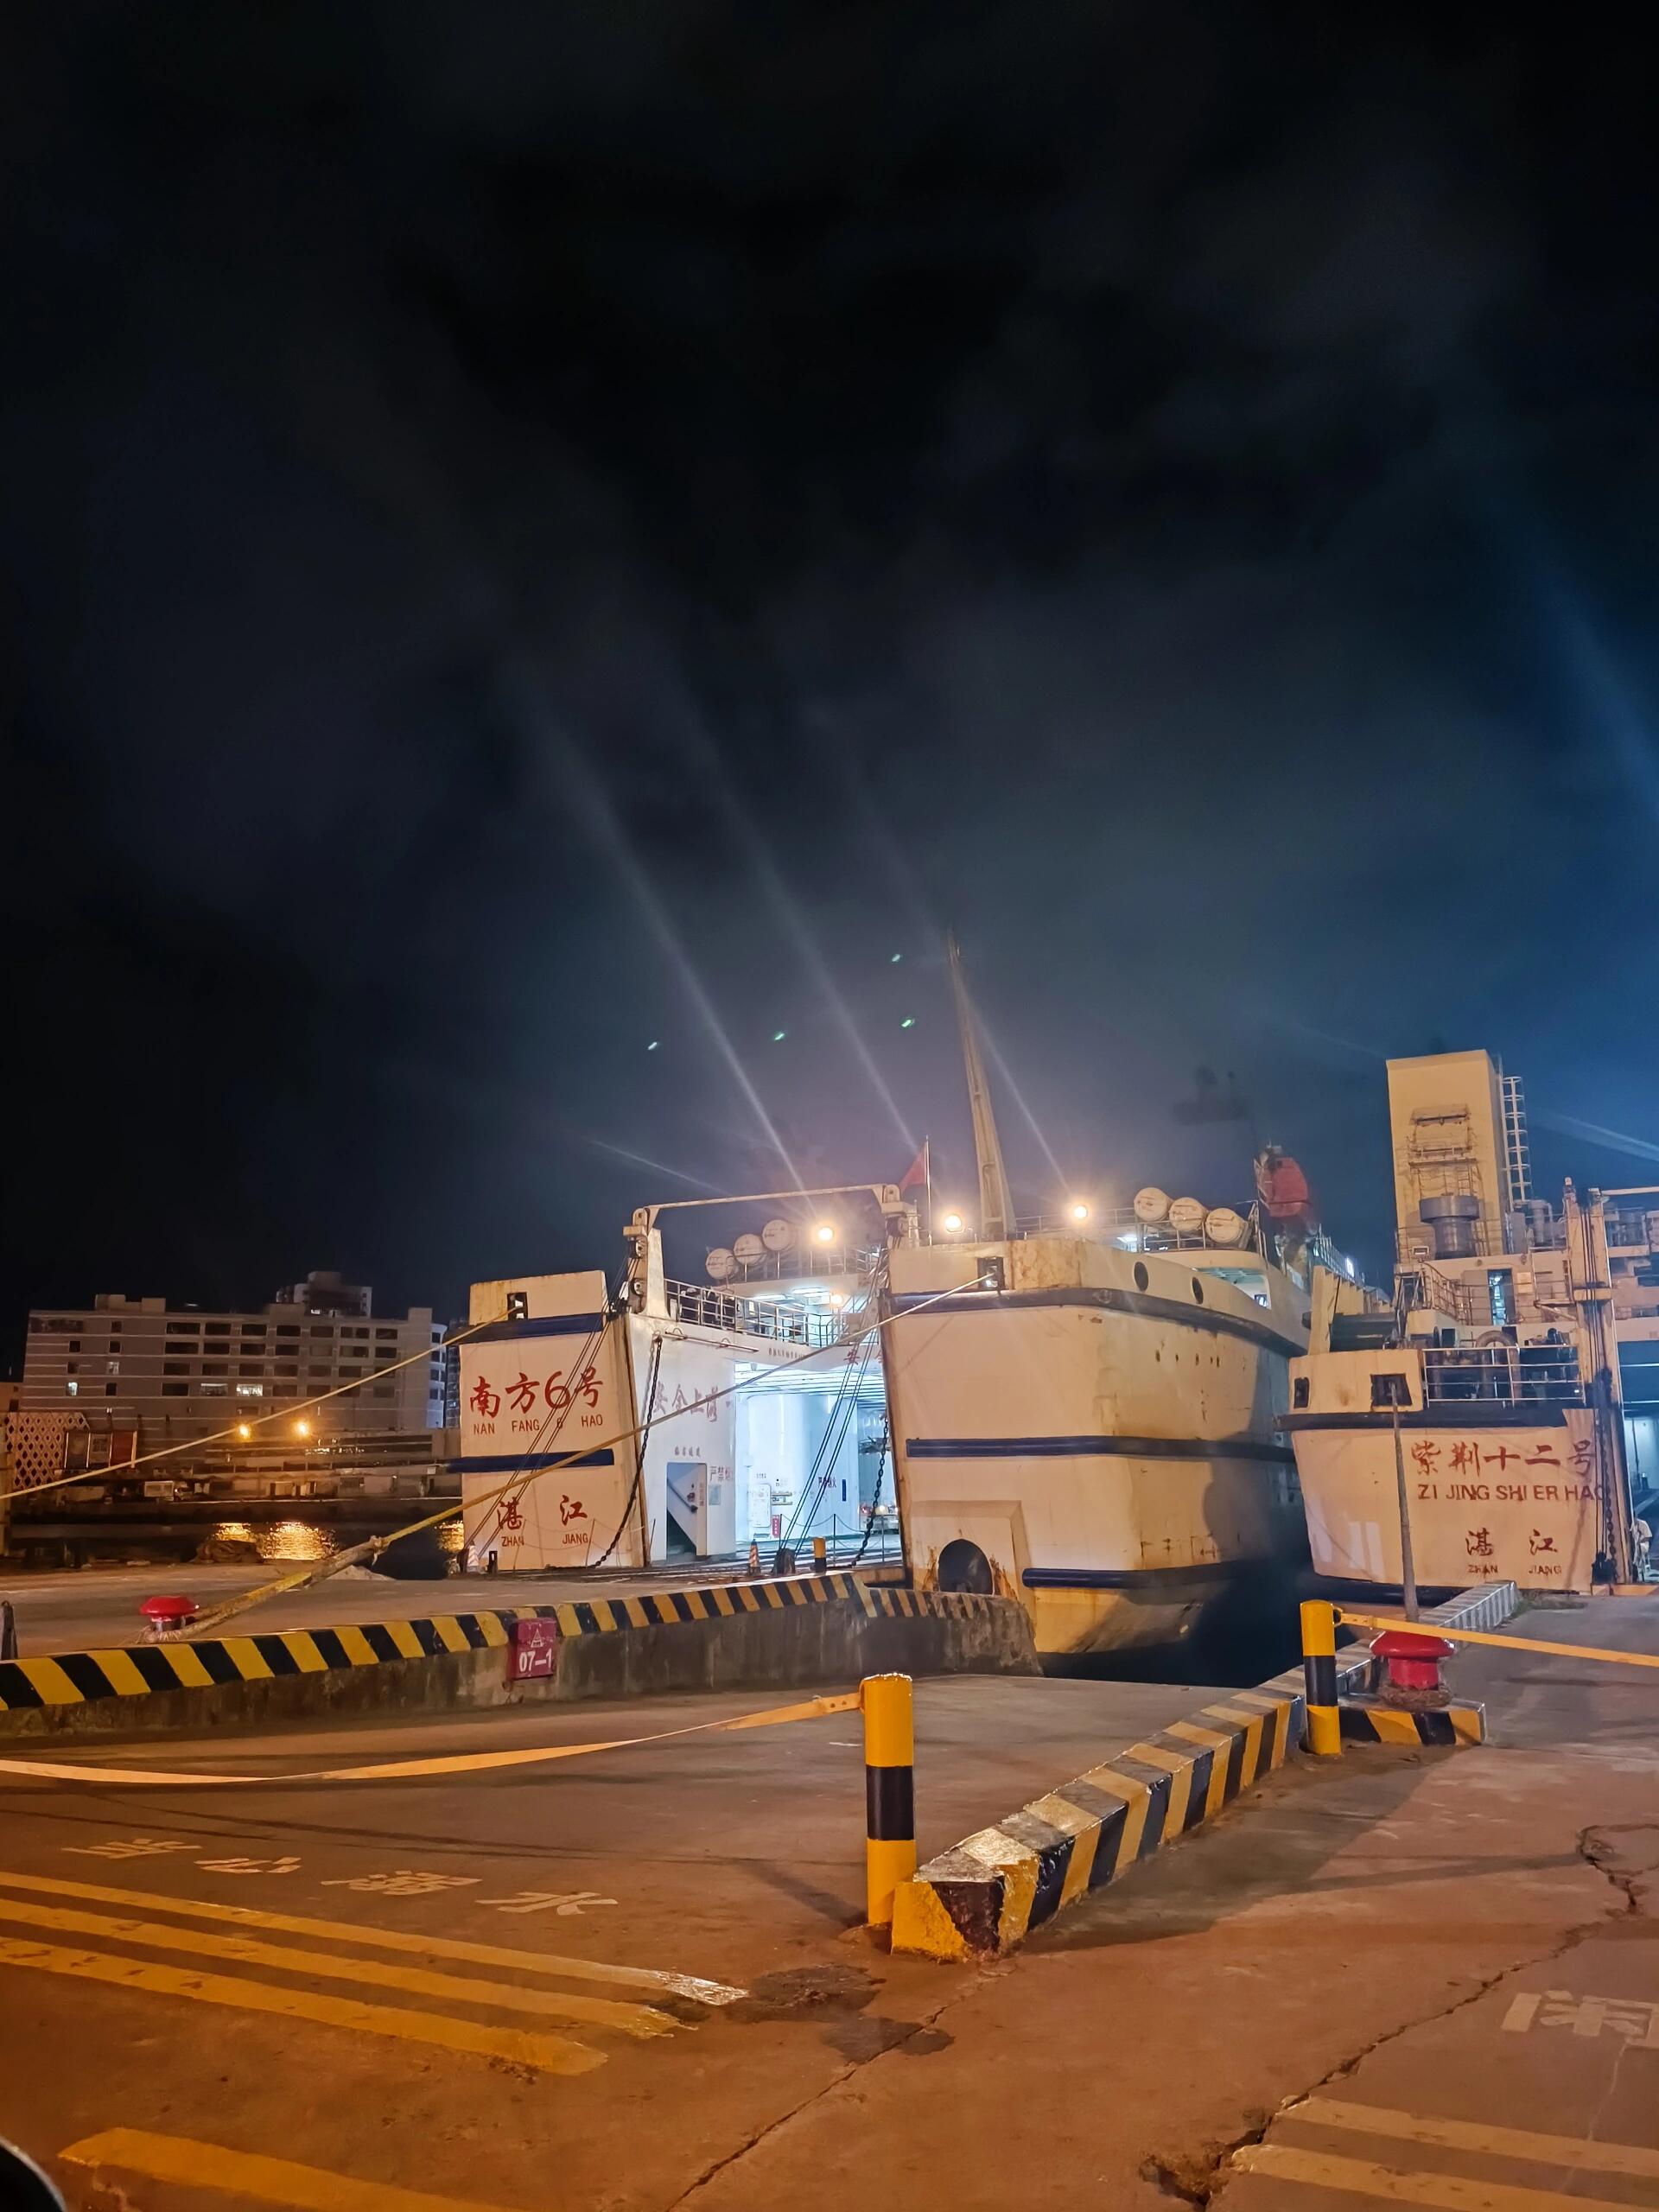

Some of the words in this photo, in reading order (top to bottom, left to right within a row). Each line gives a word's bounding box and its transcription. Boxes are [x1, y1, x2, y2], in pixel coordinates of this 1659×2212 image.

[469, 1366, 603, 1419] 南方6号
[474, 1423, 495, 1435] NAN
[512, 1419, 540, 1432] FANG
[582, 1414, 603, 1427] HAO
[1411, 1440, 1596, 1477] 紫荆十二号
[1418, 1484, 1438, 1500] ZI
[1446, 1484, 1490, 1501] JING
[1495, 1484, 1527, 1502] SHI
[1533, 1484, 1559, 1501] ER
[497, 1495, 588, 1530] 湛江
[502, 1536, 524, 1548] ZHAN
[563, 1533, 588, 1545] JIANG
[1465, 1527, 1558, 1556] 湛江
[1468, 1564, 1498, 1578] ZHAN
[1529, 1565, 1562, 1576] JIANG
[519, 1649, 552, 1672] 07-1
[61, 1838, 618, 1916] 当心溺水
